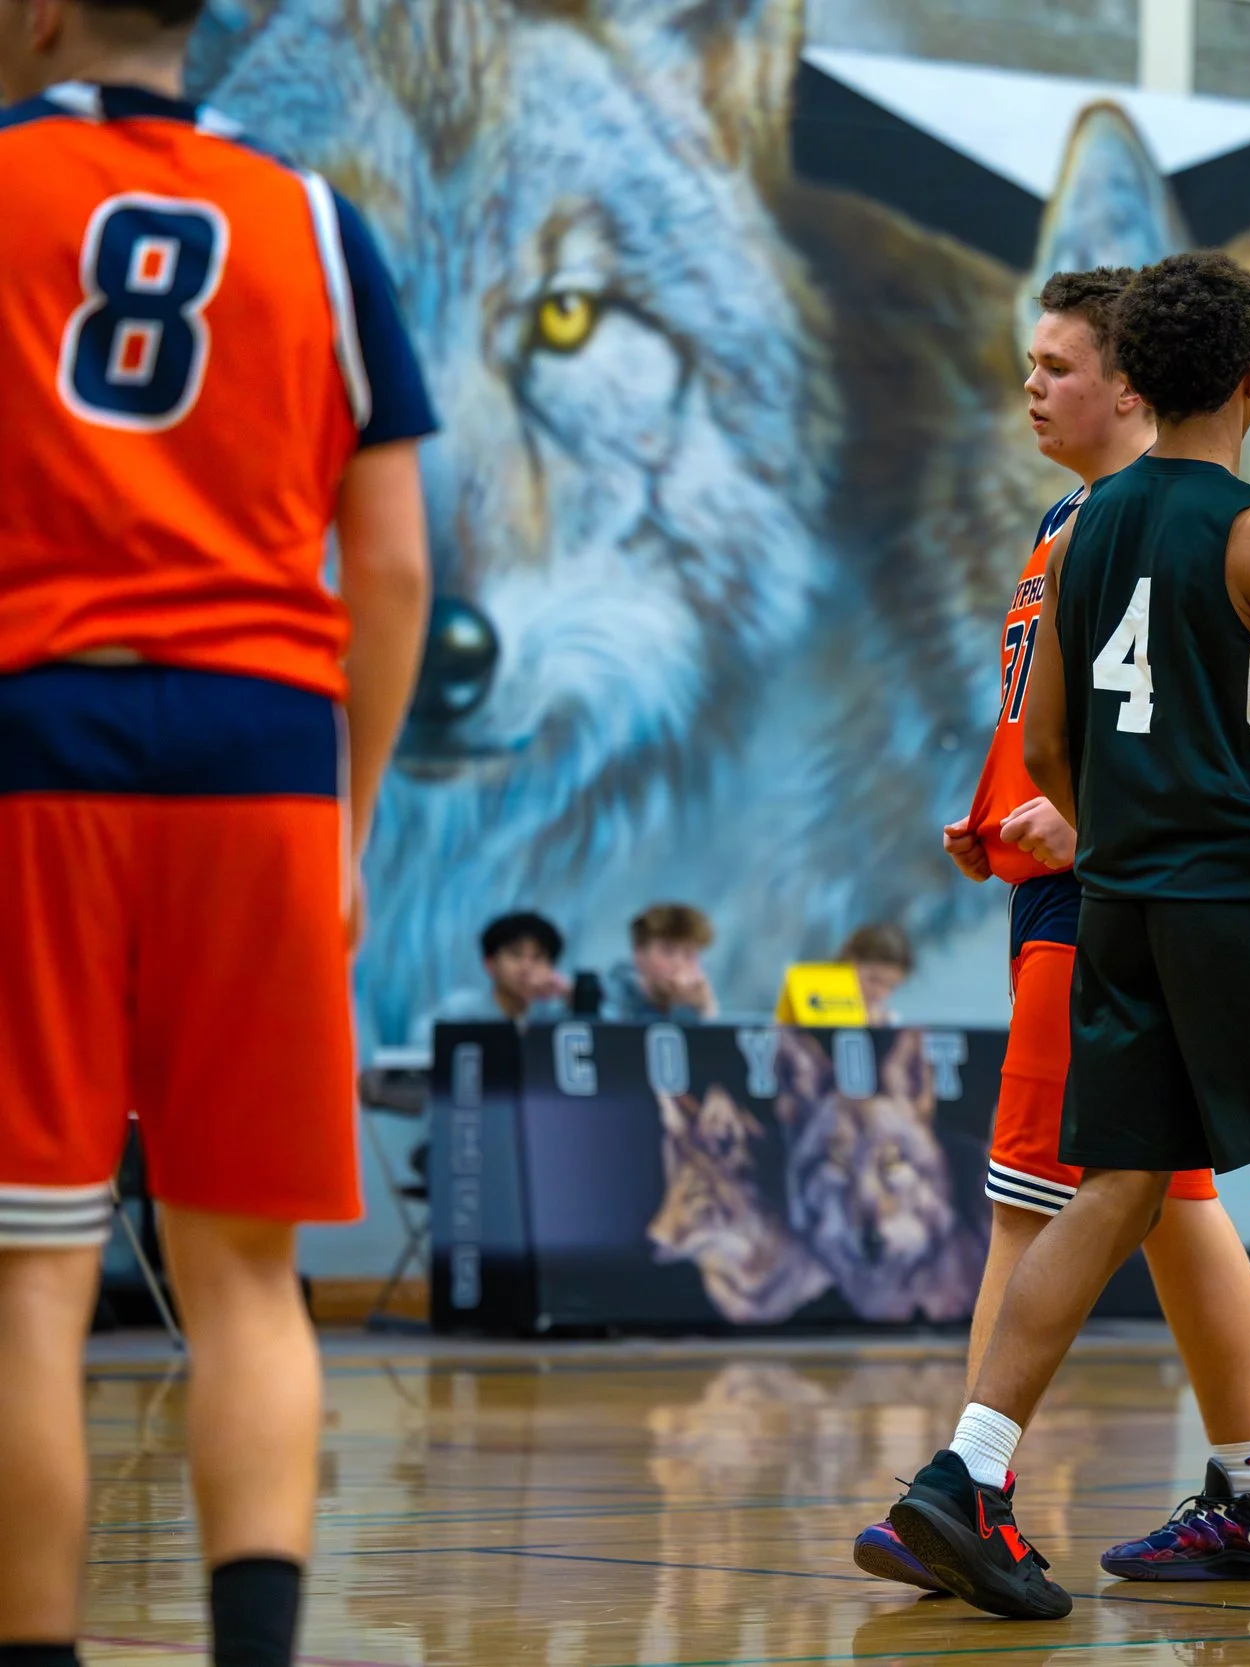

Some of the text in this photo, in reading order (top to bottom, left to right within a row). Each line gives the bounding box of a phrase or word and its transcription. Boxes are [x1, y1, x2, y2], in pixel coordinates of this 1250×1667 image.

[57, 190, 230, 432] 8
[996, 615, 1040, 730] 31
[1093, 577, 1154, 734] 4
